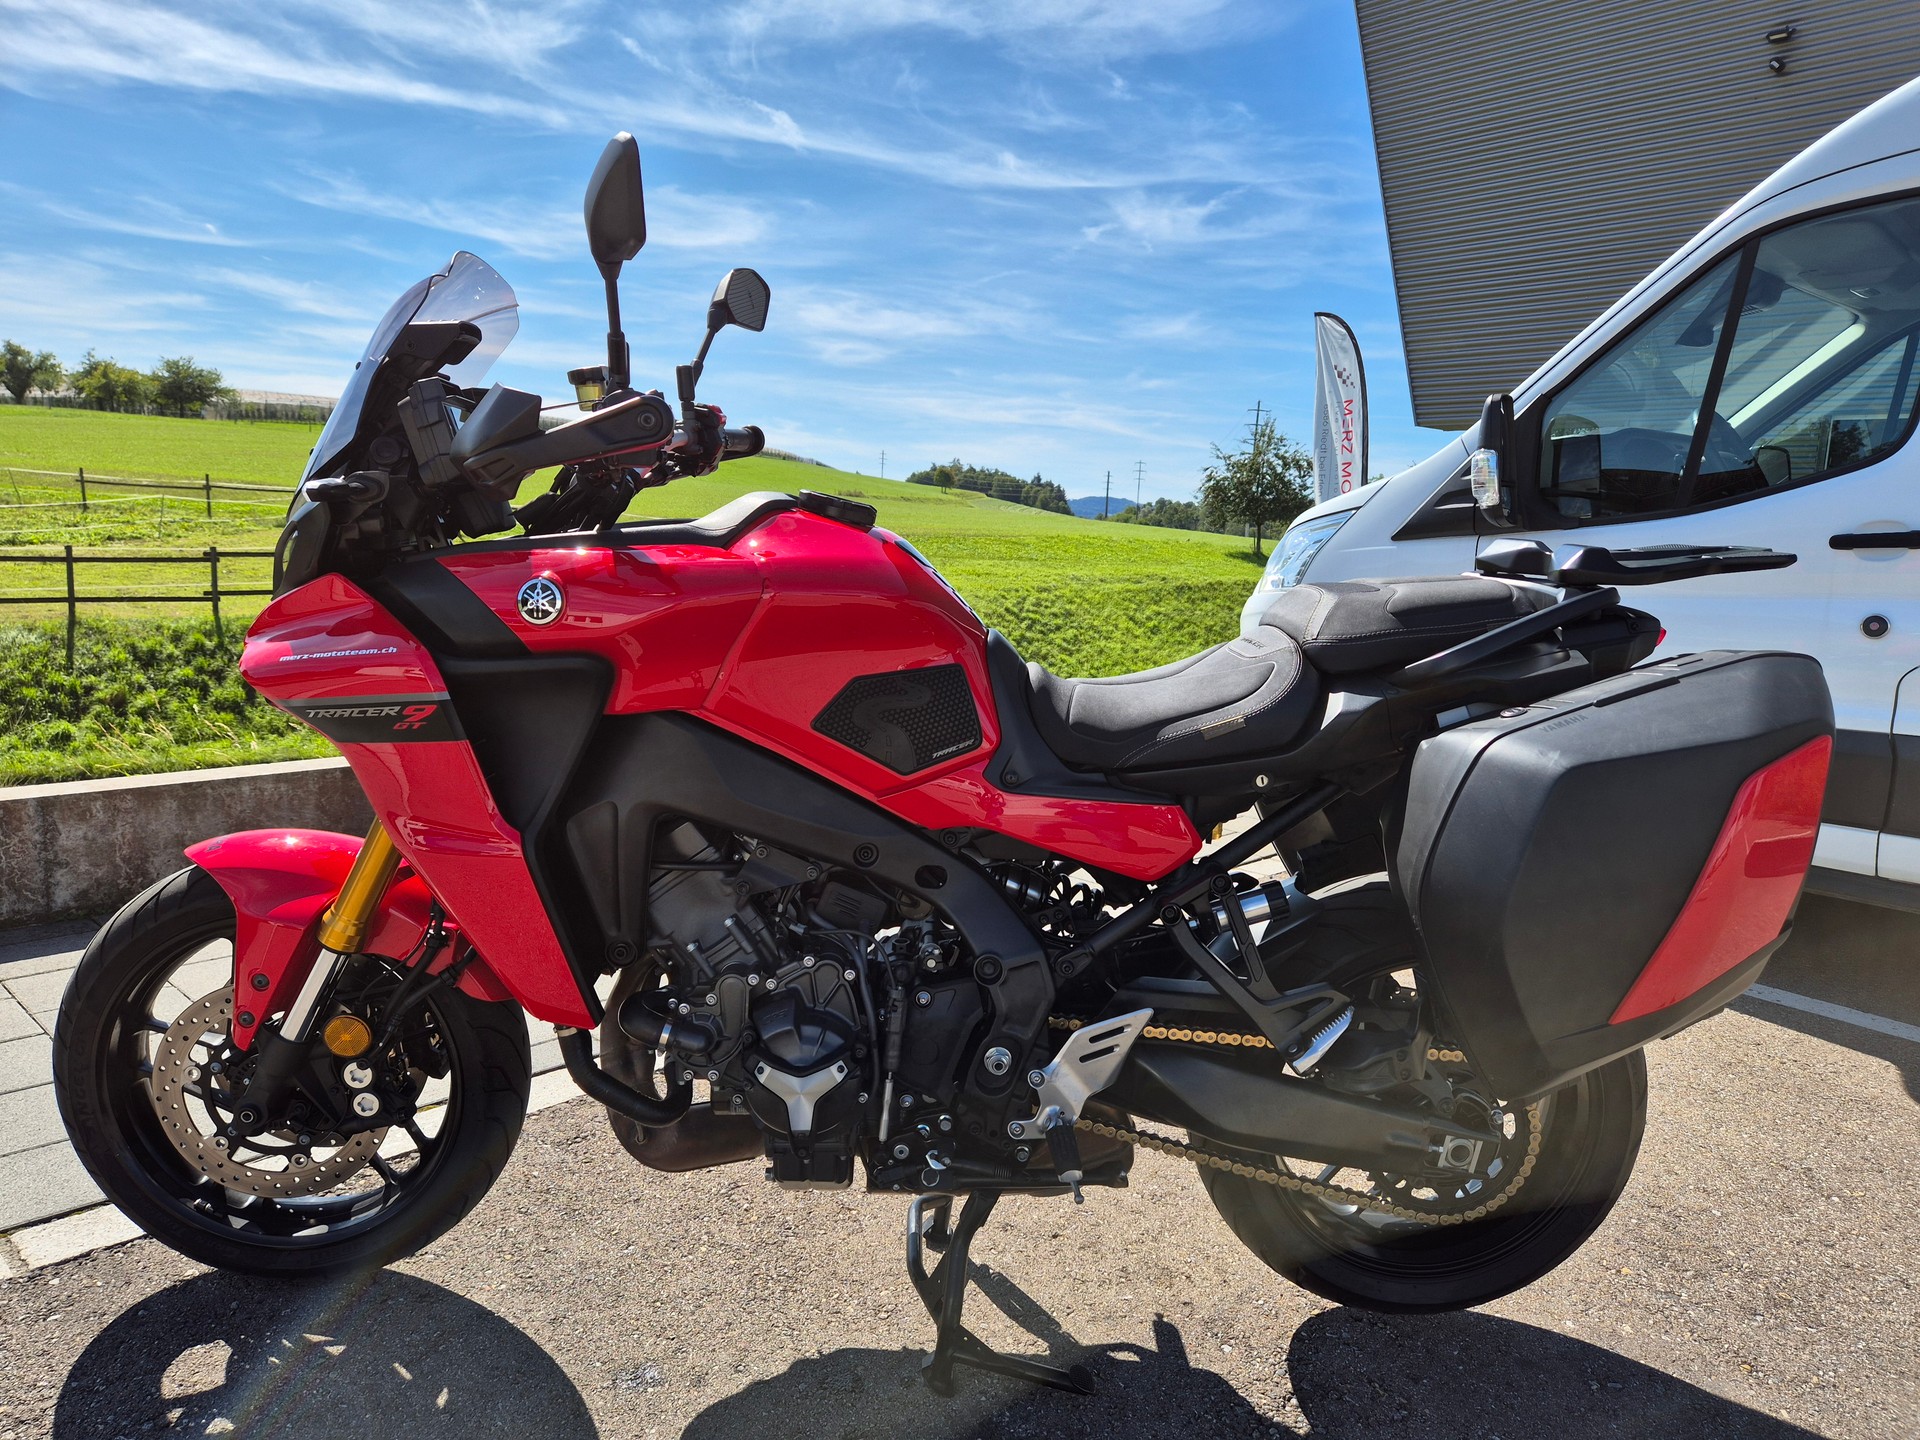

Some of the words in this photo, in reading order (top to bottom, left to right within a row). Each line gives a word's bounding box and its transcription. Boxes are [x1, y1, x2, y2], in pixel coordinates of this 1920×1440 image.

[1341, 399, 1354, 455] MERZ
[279, 646, 397, 662] merz-mototeam.ch
[306, 705, 401, 718] TRACER
[402, 705, 437, 722] 9
[393, 722, 428, 730] GT
[1540, 714, 1588, 732] YAMAHA
[932, 739, 974, 758] TRACER
